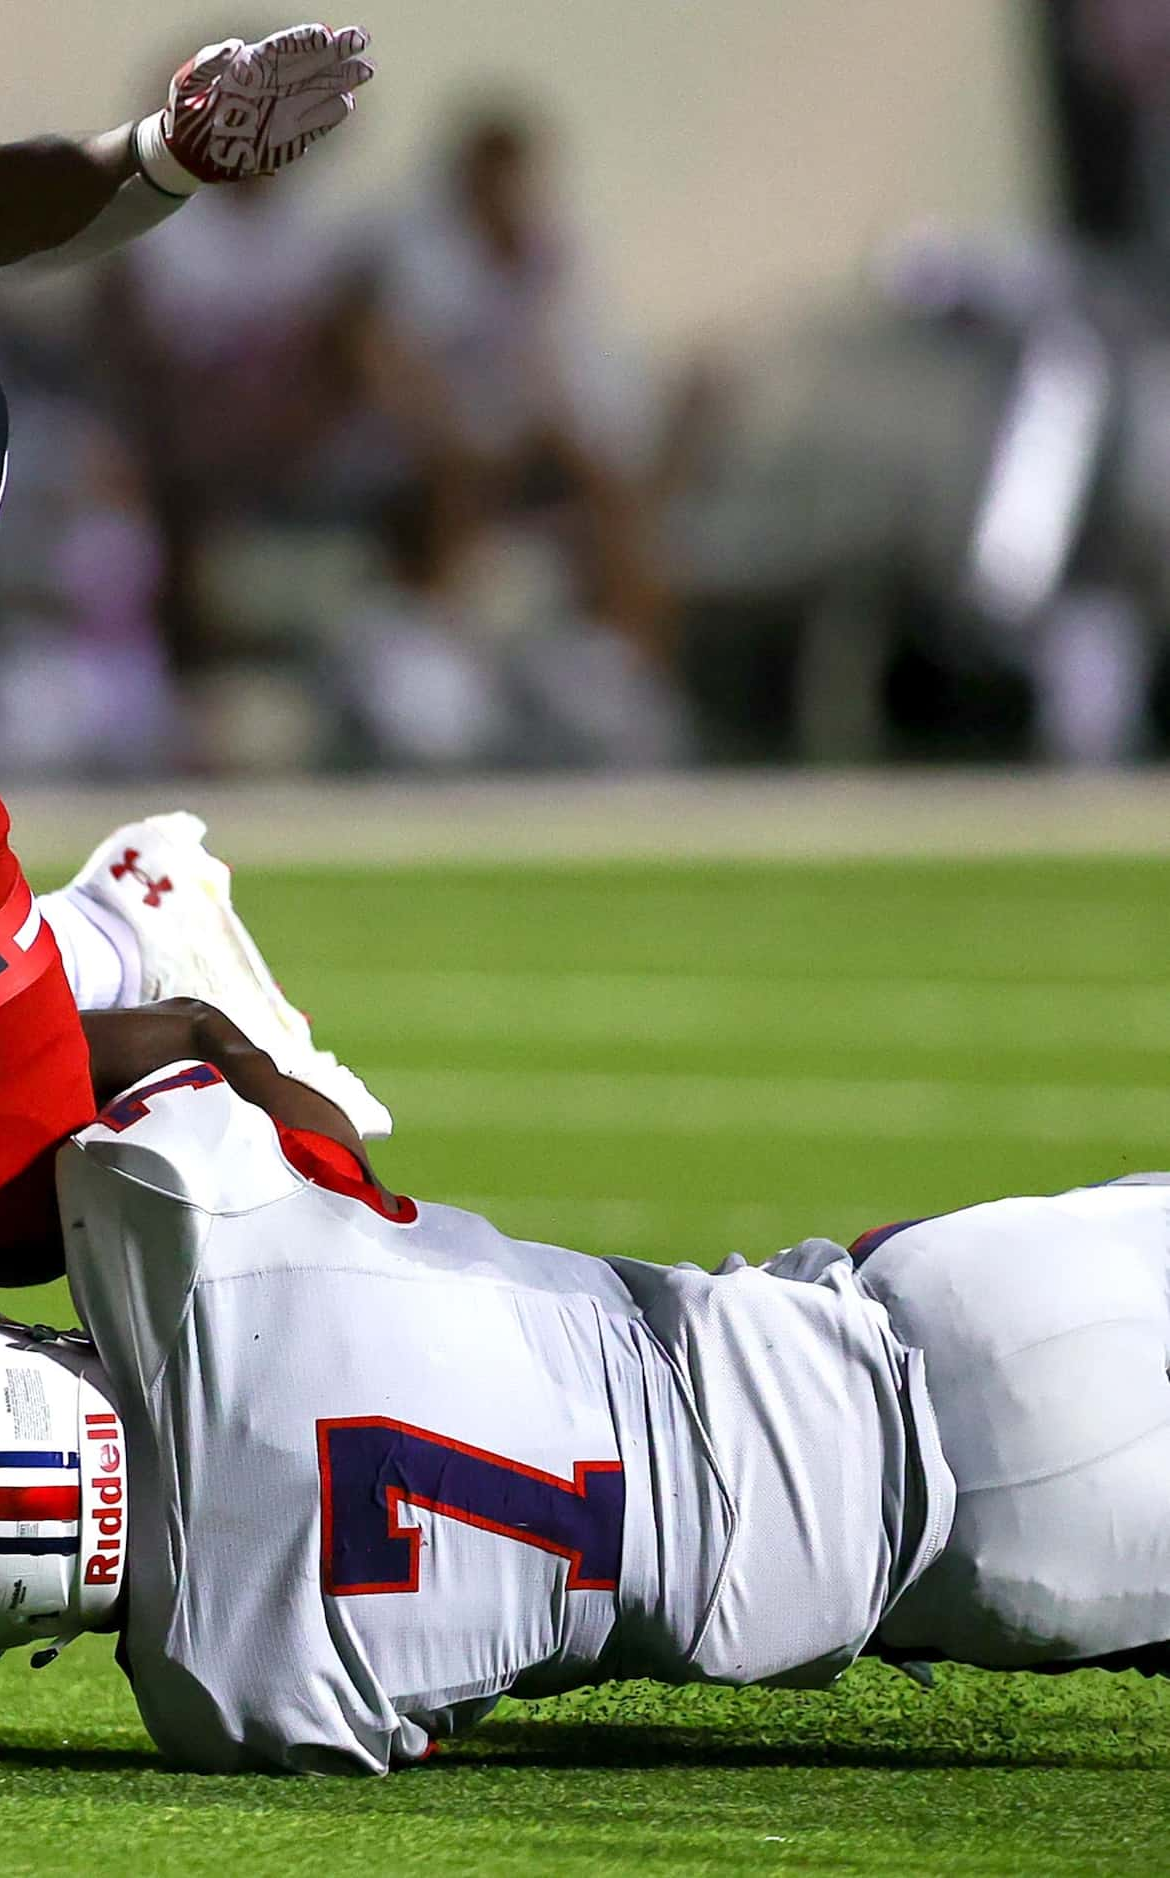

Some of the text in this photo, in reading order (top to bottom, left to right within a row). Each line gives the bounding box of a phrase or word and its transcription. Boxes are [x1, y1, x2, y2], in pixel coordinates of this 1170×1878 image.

[96, 1062, 224, 1133] 7
[84, 1413, 122, 1585] Riddell
[316, 1415, 626, 1596] 7
